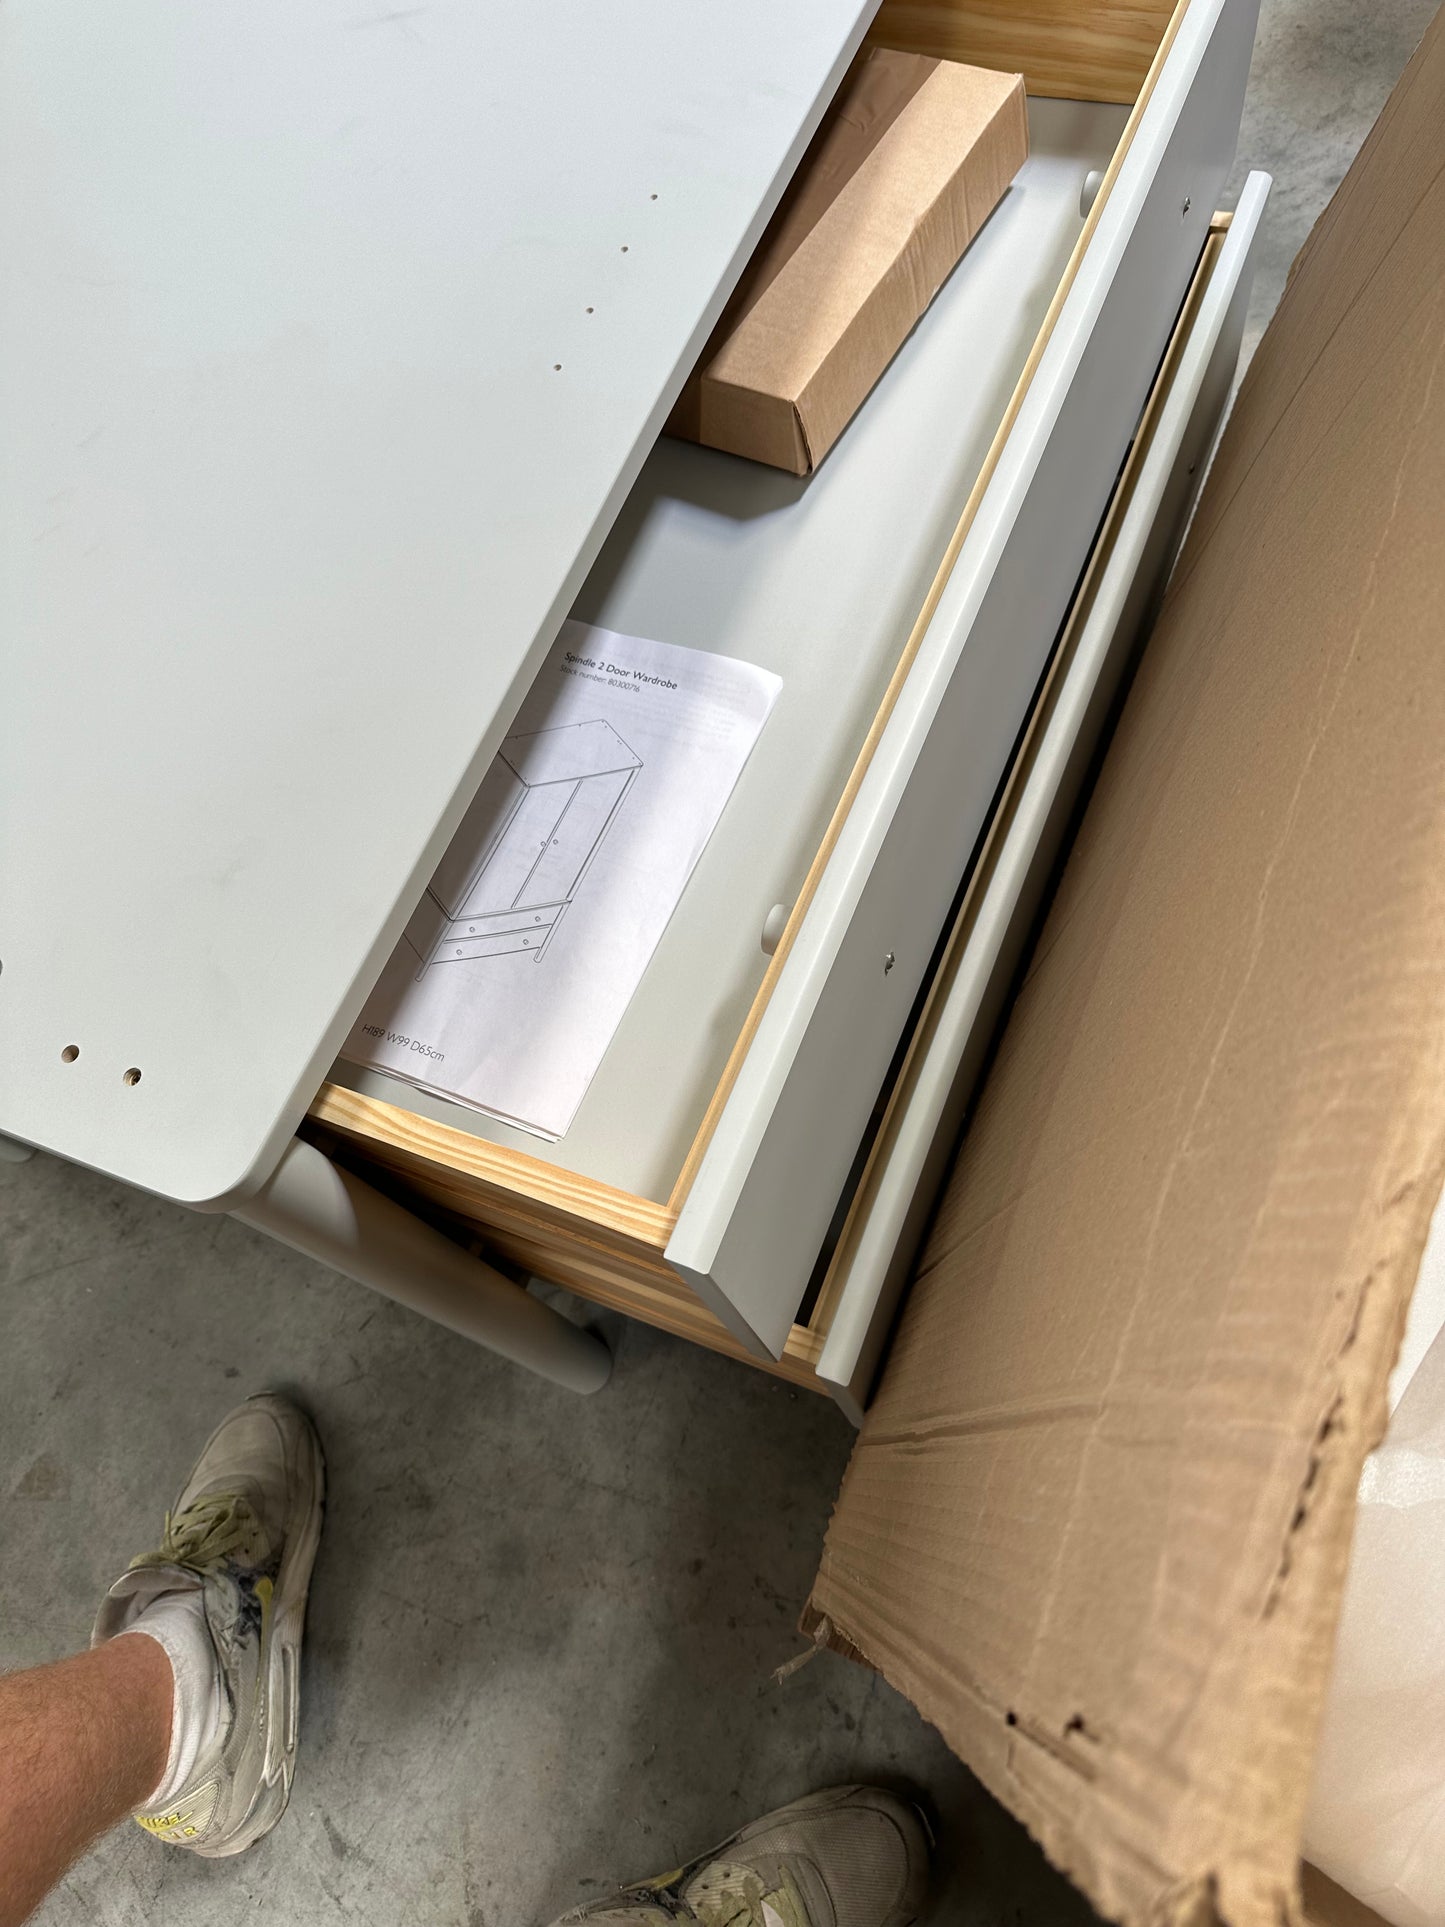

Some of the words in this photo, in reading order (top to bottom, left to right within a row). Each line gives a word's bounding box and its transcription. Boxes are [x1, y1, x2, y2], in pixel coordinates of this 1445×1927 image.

[560, 664, 578, 676] Stock
[579, 671, 607, 683] number:
[608, 678, 640, 692] 80300716
[564, 652, 596, 668] Spindle
[598, 662, 605, 671] 2
[606, 664, 631, 677] Door
[633, 670, 678, 690] Wardrobe
[362, 1023, 386, 1038] H189
[387, 1031, 410, 1047] W99
[410, 1040, 445, 1062] D65cm
